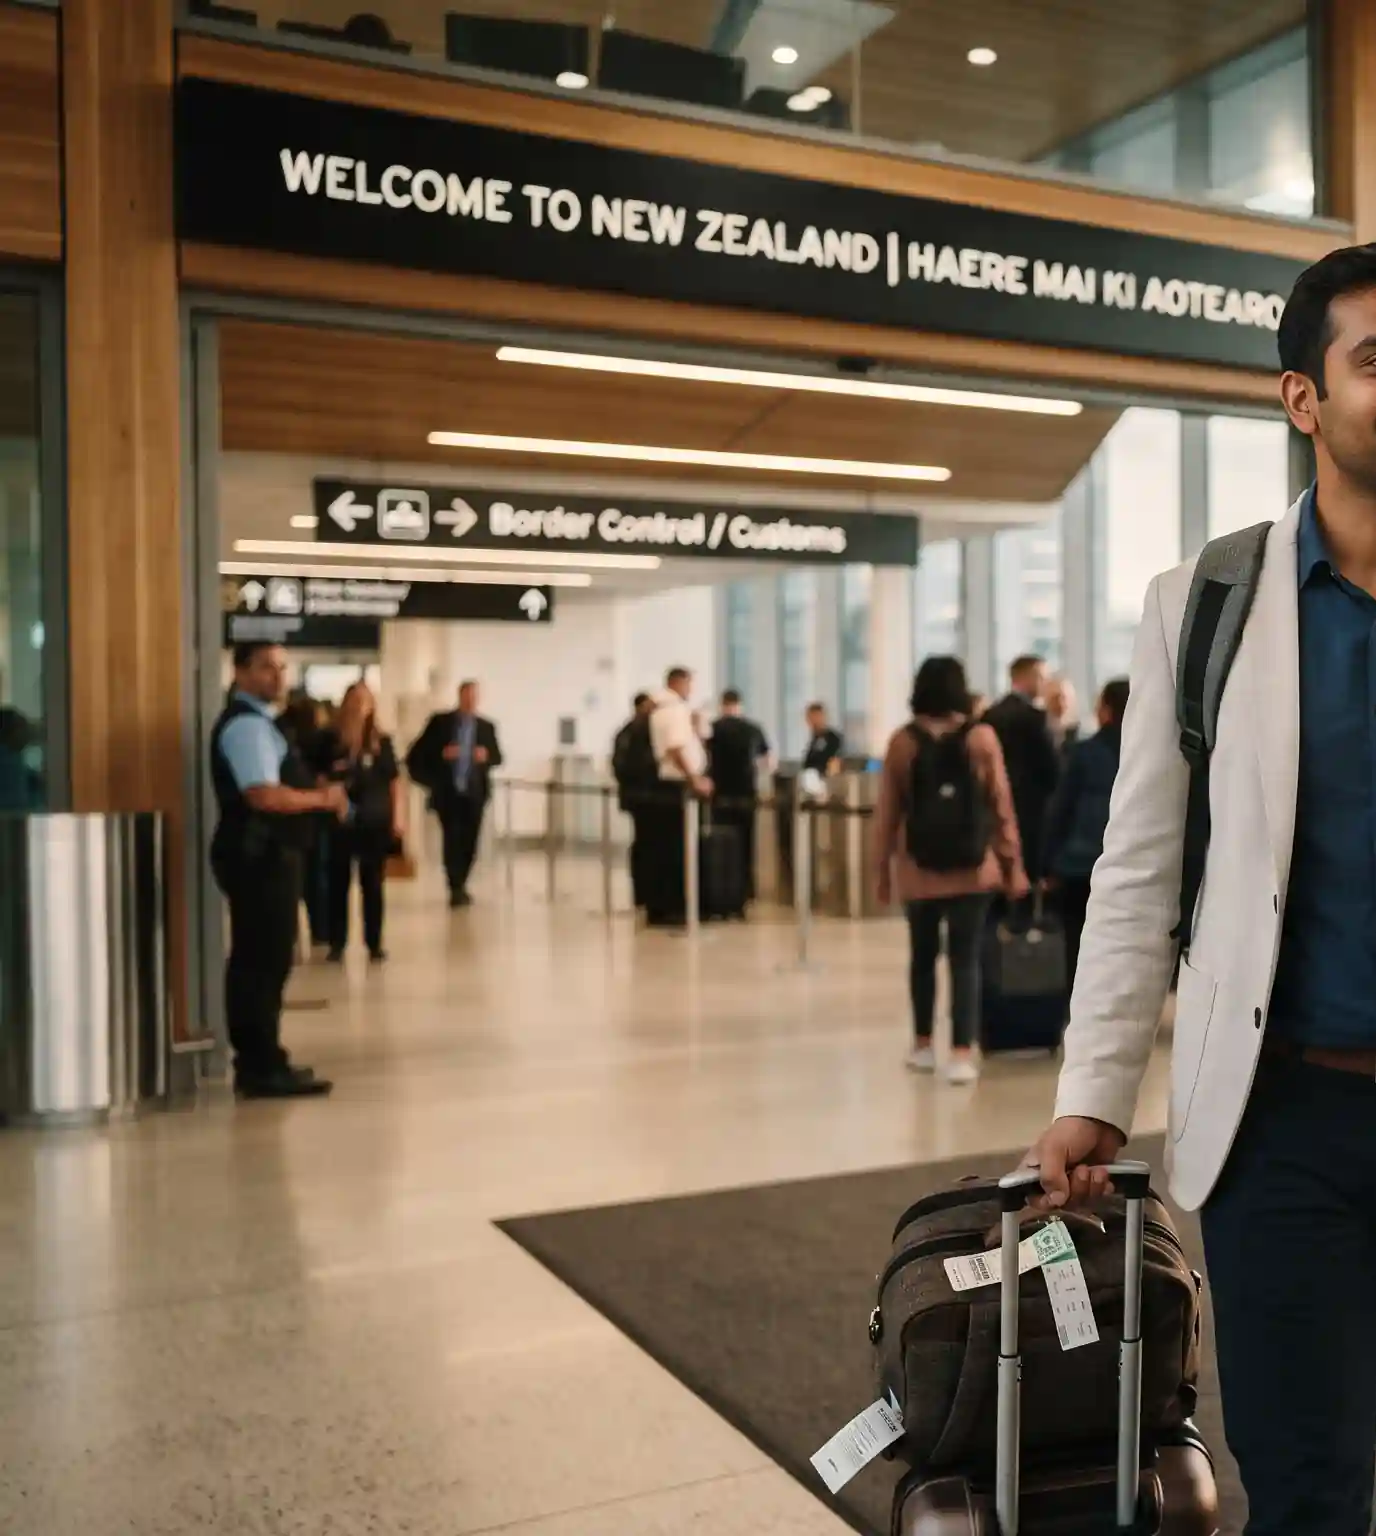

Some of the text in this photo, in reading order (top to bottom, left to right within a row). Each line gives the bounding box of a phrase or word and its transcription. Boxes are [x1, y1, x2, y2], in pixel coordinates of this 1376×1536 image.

[279, 148, 513, 223] WELCOME
[521, 184, 582, 232] TO
[591, 194, 687, 246] NEW
[694, 209, 880, 274] ZEALAND
[907, 242, 1028, 295] HAERE
[1033, 259, 1096, 304] MAI
[1102, 269, 1136, 309] KI
[1141, 276, 1287, 331] AOTEARO
[489, 502, 595, 540] Border
[598, 508, 706, 546] Control
[728, 515, 848, 553] Customs
